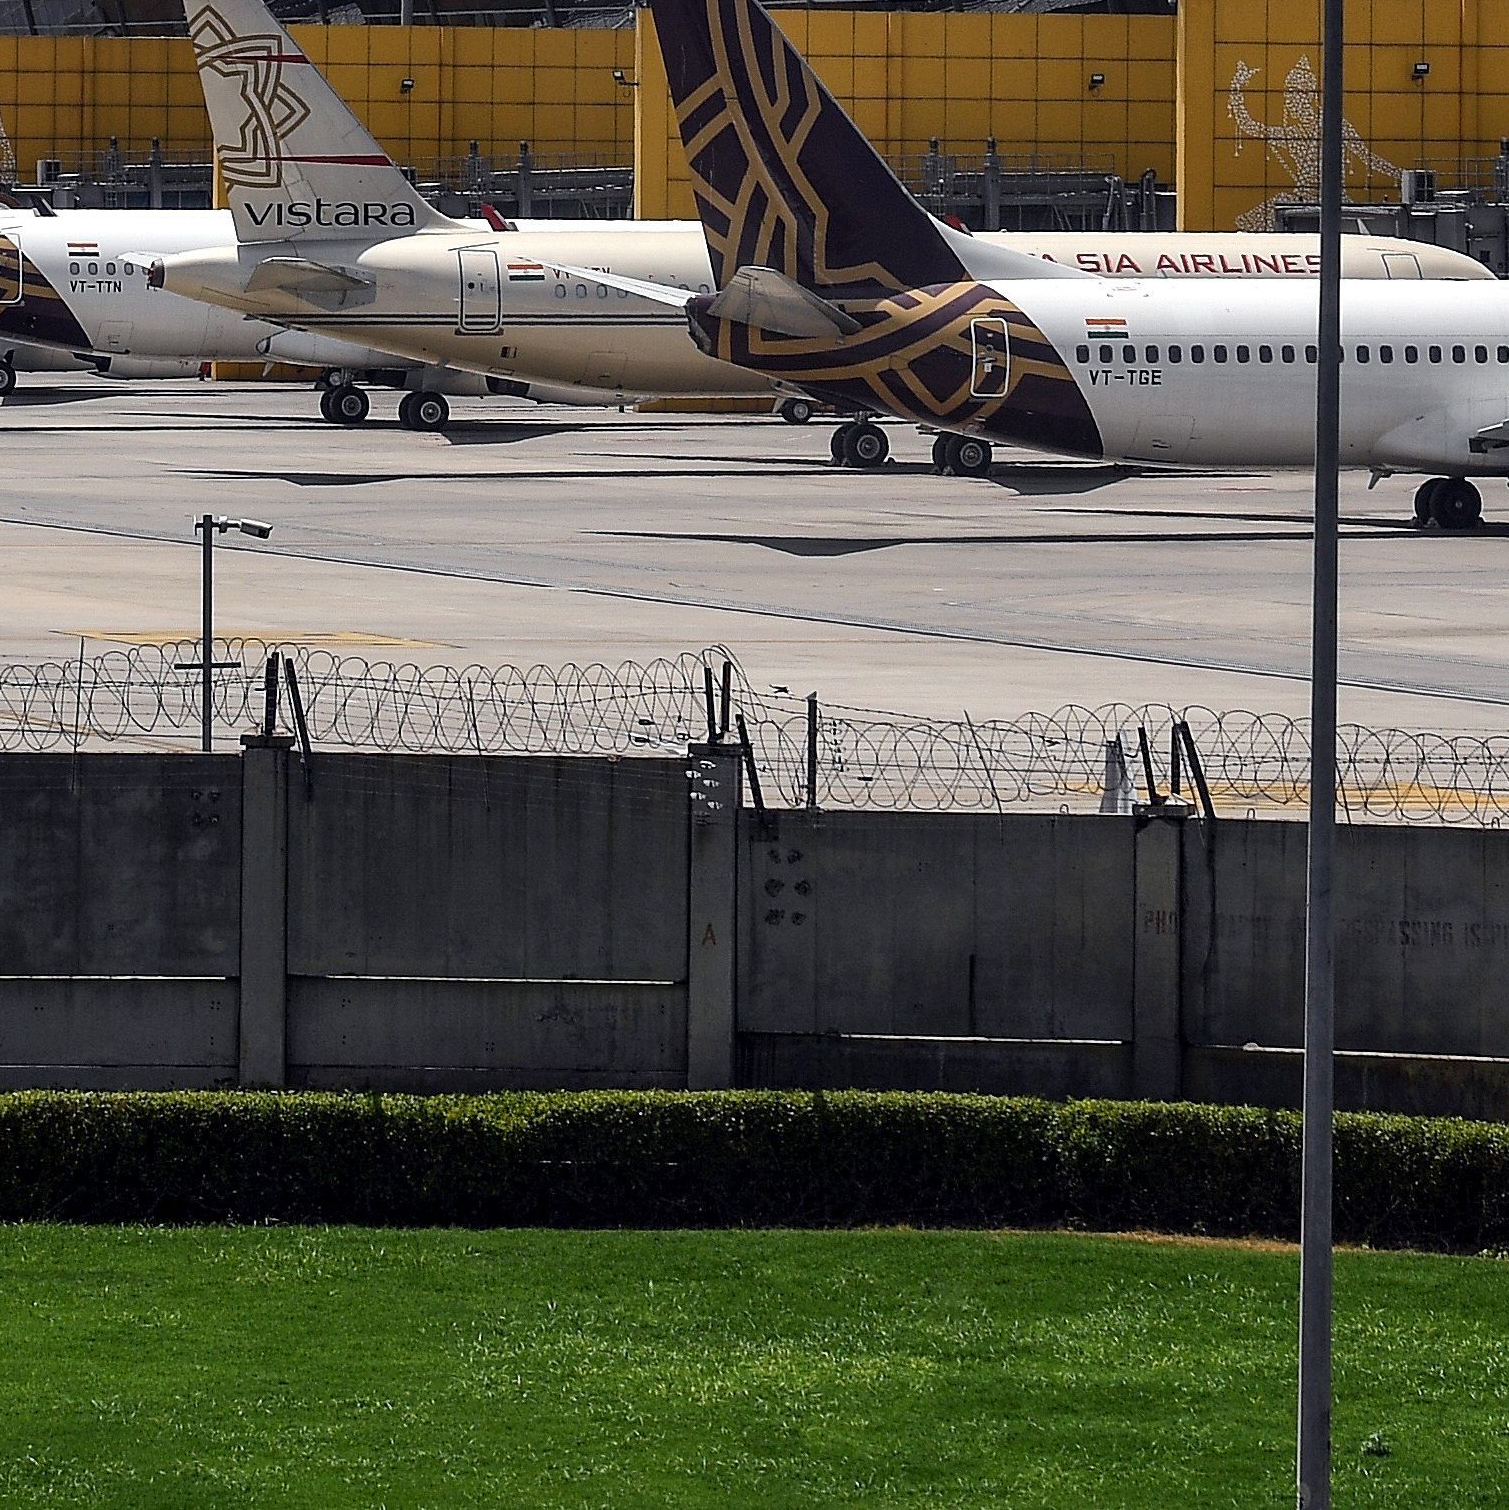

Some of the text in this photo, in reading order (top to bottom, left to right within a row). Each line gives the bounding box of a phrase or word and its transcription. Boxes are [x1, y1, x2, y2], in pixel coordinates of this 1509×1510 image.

[1076, 253, 1141, 274] SIA
[1156, 253, 1321, 274] AIRLINES
[70, 280, 122, 293] VT-TTN
[1089, 369, 1163, 386] VT-TGE
